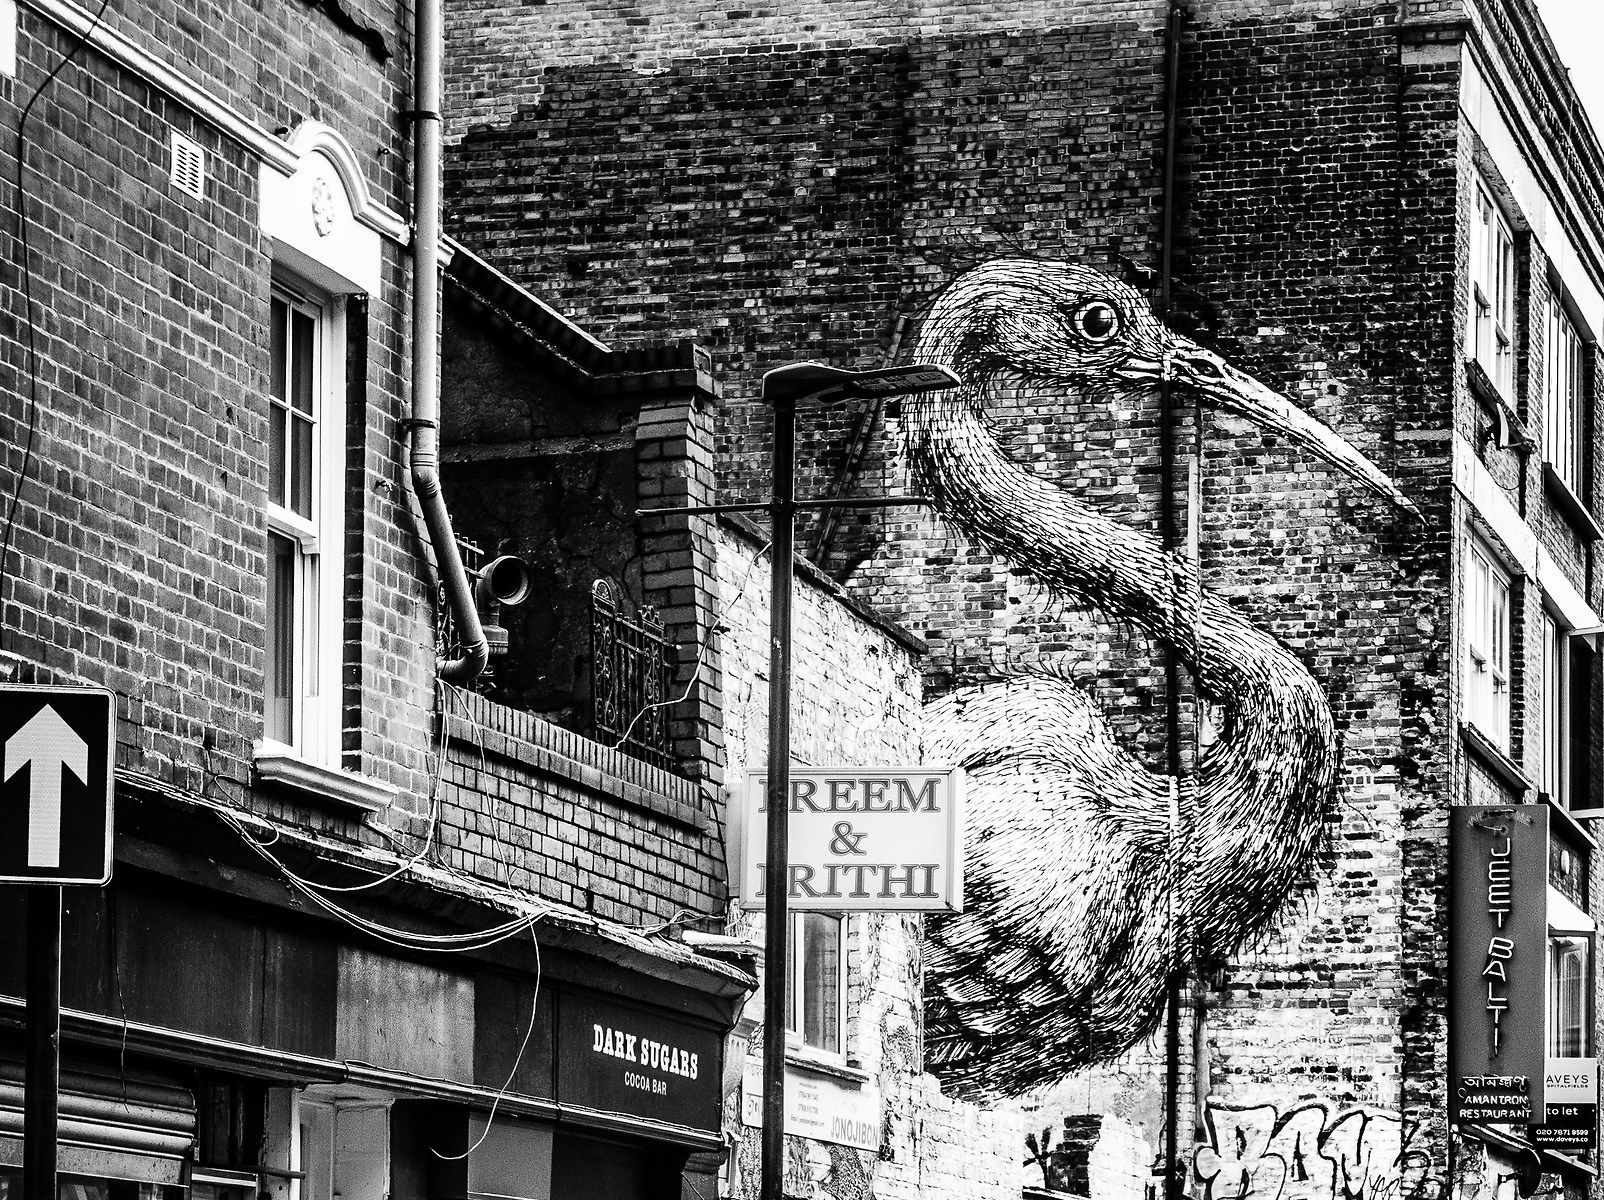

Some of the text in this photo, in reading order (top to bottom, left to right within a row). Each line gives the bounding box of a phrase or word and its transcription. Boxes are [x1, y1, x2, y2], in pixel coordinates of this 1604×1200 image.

[829, 821, 867, 856] &
[1488, 837, 1511, 928] JEET
[1482, 936, 1515, 1057] BALTI
[593, 1023, 637, 1062] DARK
[640, 1037, 698, 1080] SUGARS
[624, 1071, 667, 1096] COCOA BAR
[1546, 1075, 1589, 1084] AVEYS
[1464, 1095, 1528, 1105] AMANTRON
[1546, 1106, 1578, 1116] to let
[1459, 1109, 1532, 1119] RESTAURANT
